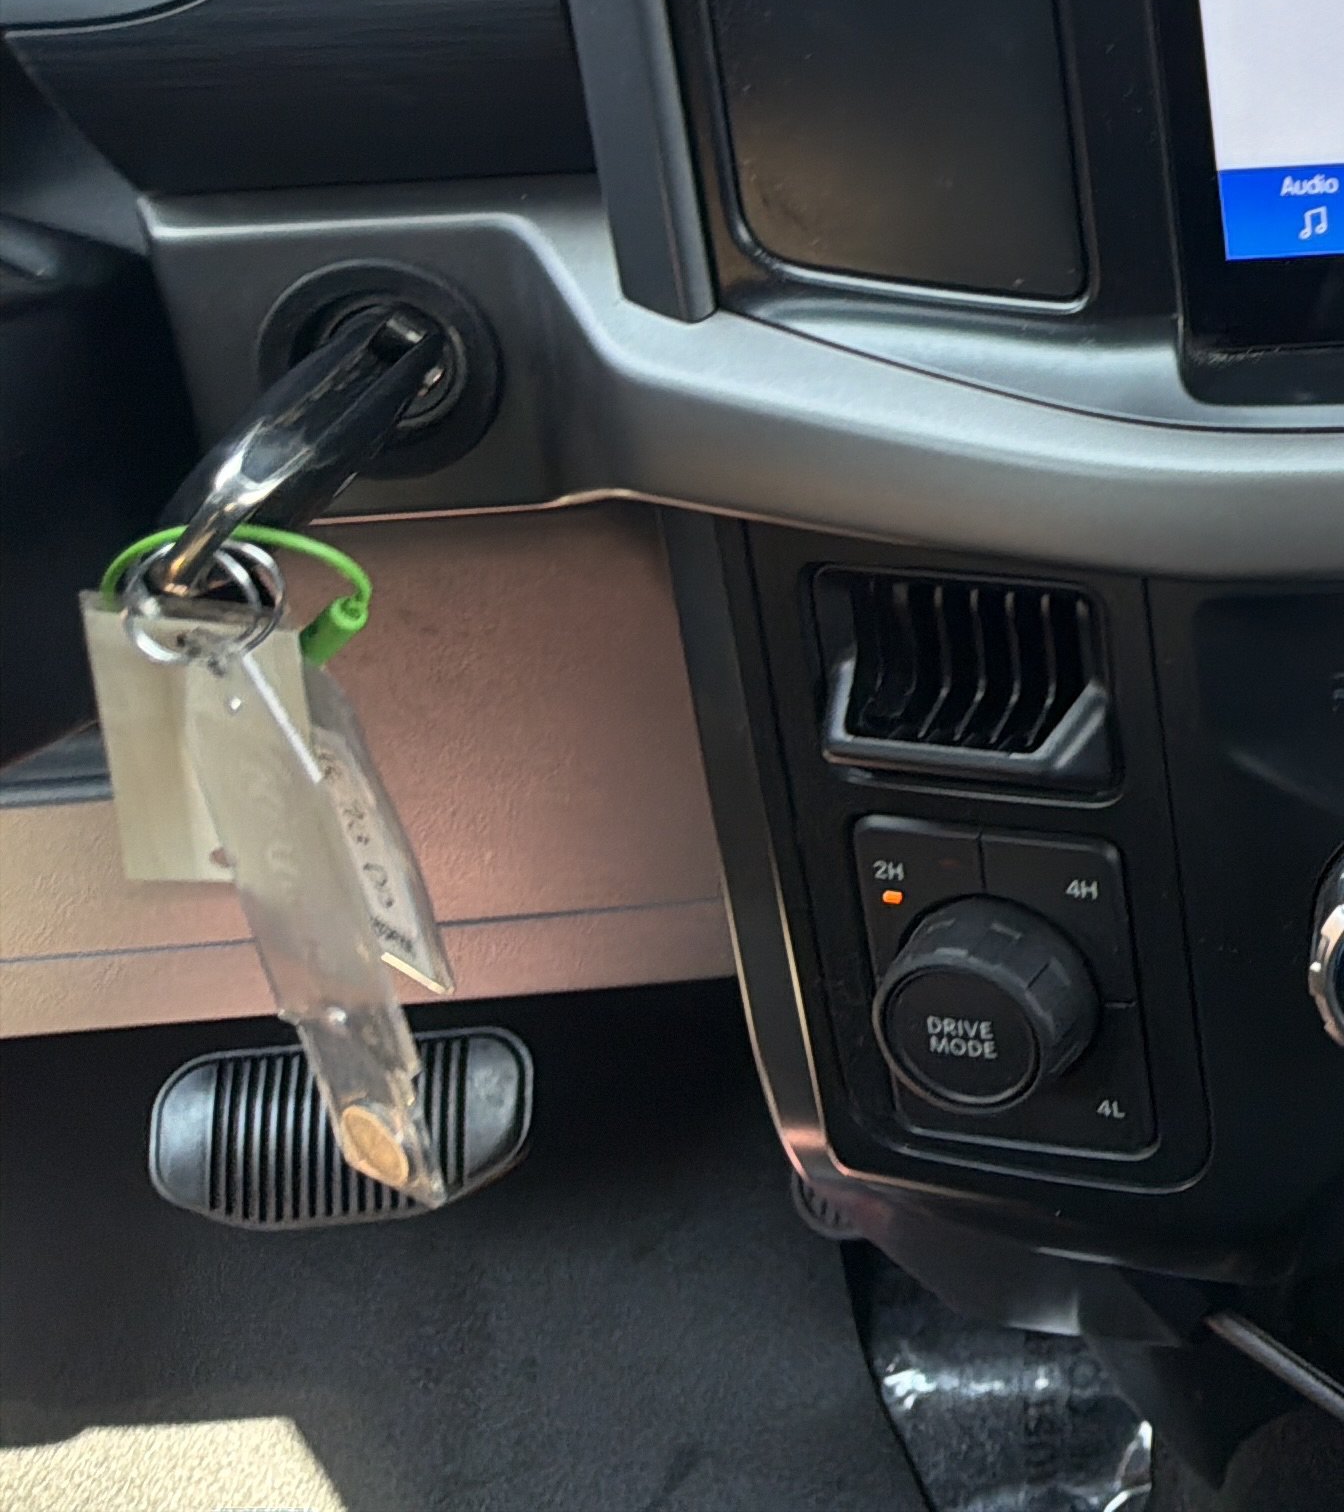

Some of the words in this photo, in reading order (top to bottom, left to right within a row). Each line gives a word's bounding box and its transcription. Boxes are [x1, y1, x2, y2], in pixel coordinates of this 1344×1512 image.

[1280, 175, 1339, 196] Audio
[873, 861, 904, 880] 2H
[1066, 880, 1097, 899] 4H
[927, 1015, 994, 1039] DRIVE
[930, 1037, 997, 1059] MODE
[1097, 1100, 1125, 1118] 4L
